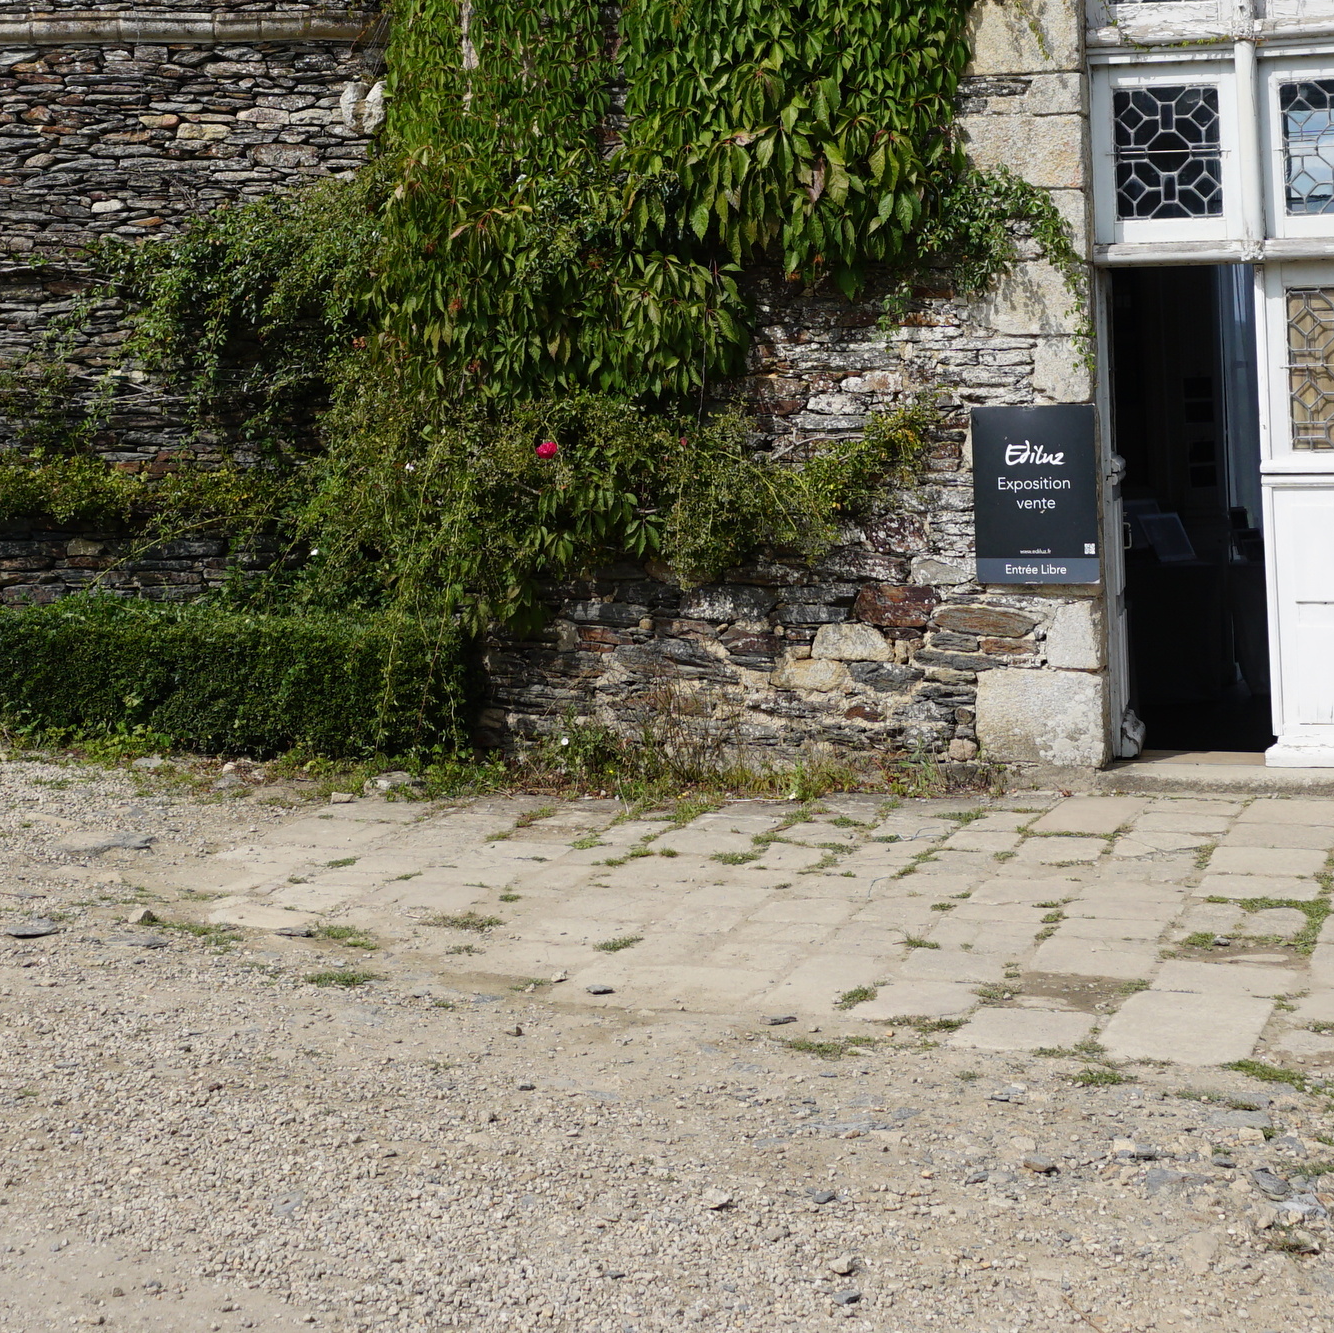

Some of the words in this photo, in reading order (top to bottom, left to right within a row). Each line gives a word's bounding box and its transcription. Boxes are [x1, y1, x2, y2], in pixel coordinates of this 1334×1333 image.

[1005, 440, 1066, 466] Ediluz
[997, 477, 1071, 493] Exposition
[1016, 498, 1056, 510] vente
[1005, 563, 1038, 575] Entrée
[1041, 563, 1067, 575] Libre
